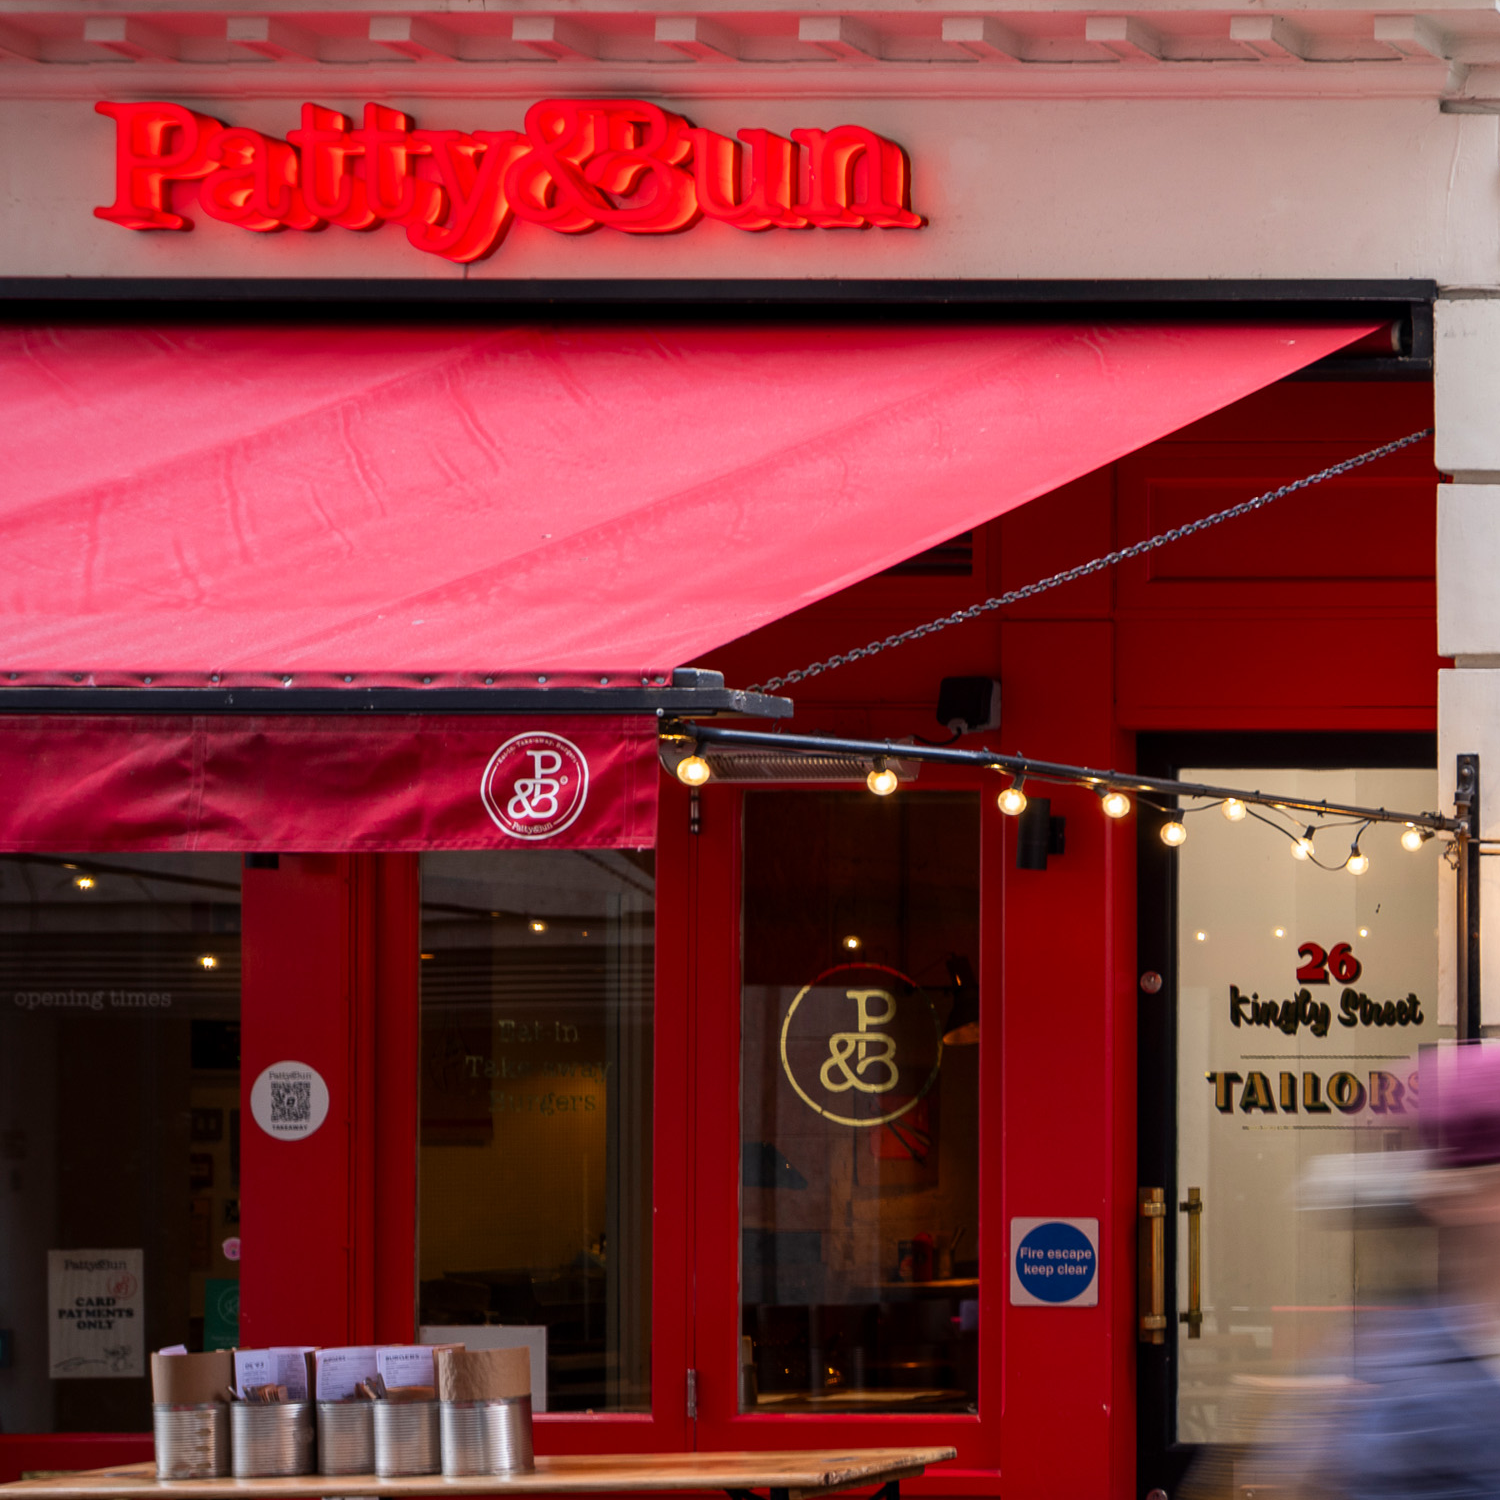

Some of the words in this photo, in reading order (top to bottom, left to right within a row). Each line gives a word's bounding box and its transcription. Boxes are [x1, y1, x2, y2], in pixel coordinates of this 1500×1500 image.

[93, 98, 928, 264] Patty&Bun
[1296, 941, 1362, 985] 26
[14, 988, 104, 1011] opening
[110, 989, 172, 1007] times
[1229, 984, 1332, 1038] Kingly
[1337, 987, 1424, 1028] Street
[488, 1090, 597, 1117] Burgers
[1020, 1247, 1044, 1259] Fire
[1047, 1249, 1092, 1262] escape
[1024, 1263, 1054, 1278] keep
[1057, 1263, 1088, 1275] clear
[75, 1297, 116, 1308] CARD
[58, 1308, 134, 1320] PAYMENTS
[76, 1320, 115, 1330] ONLY
